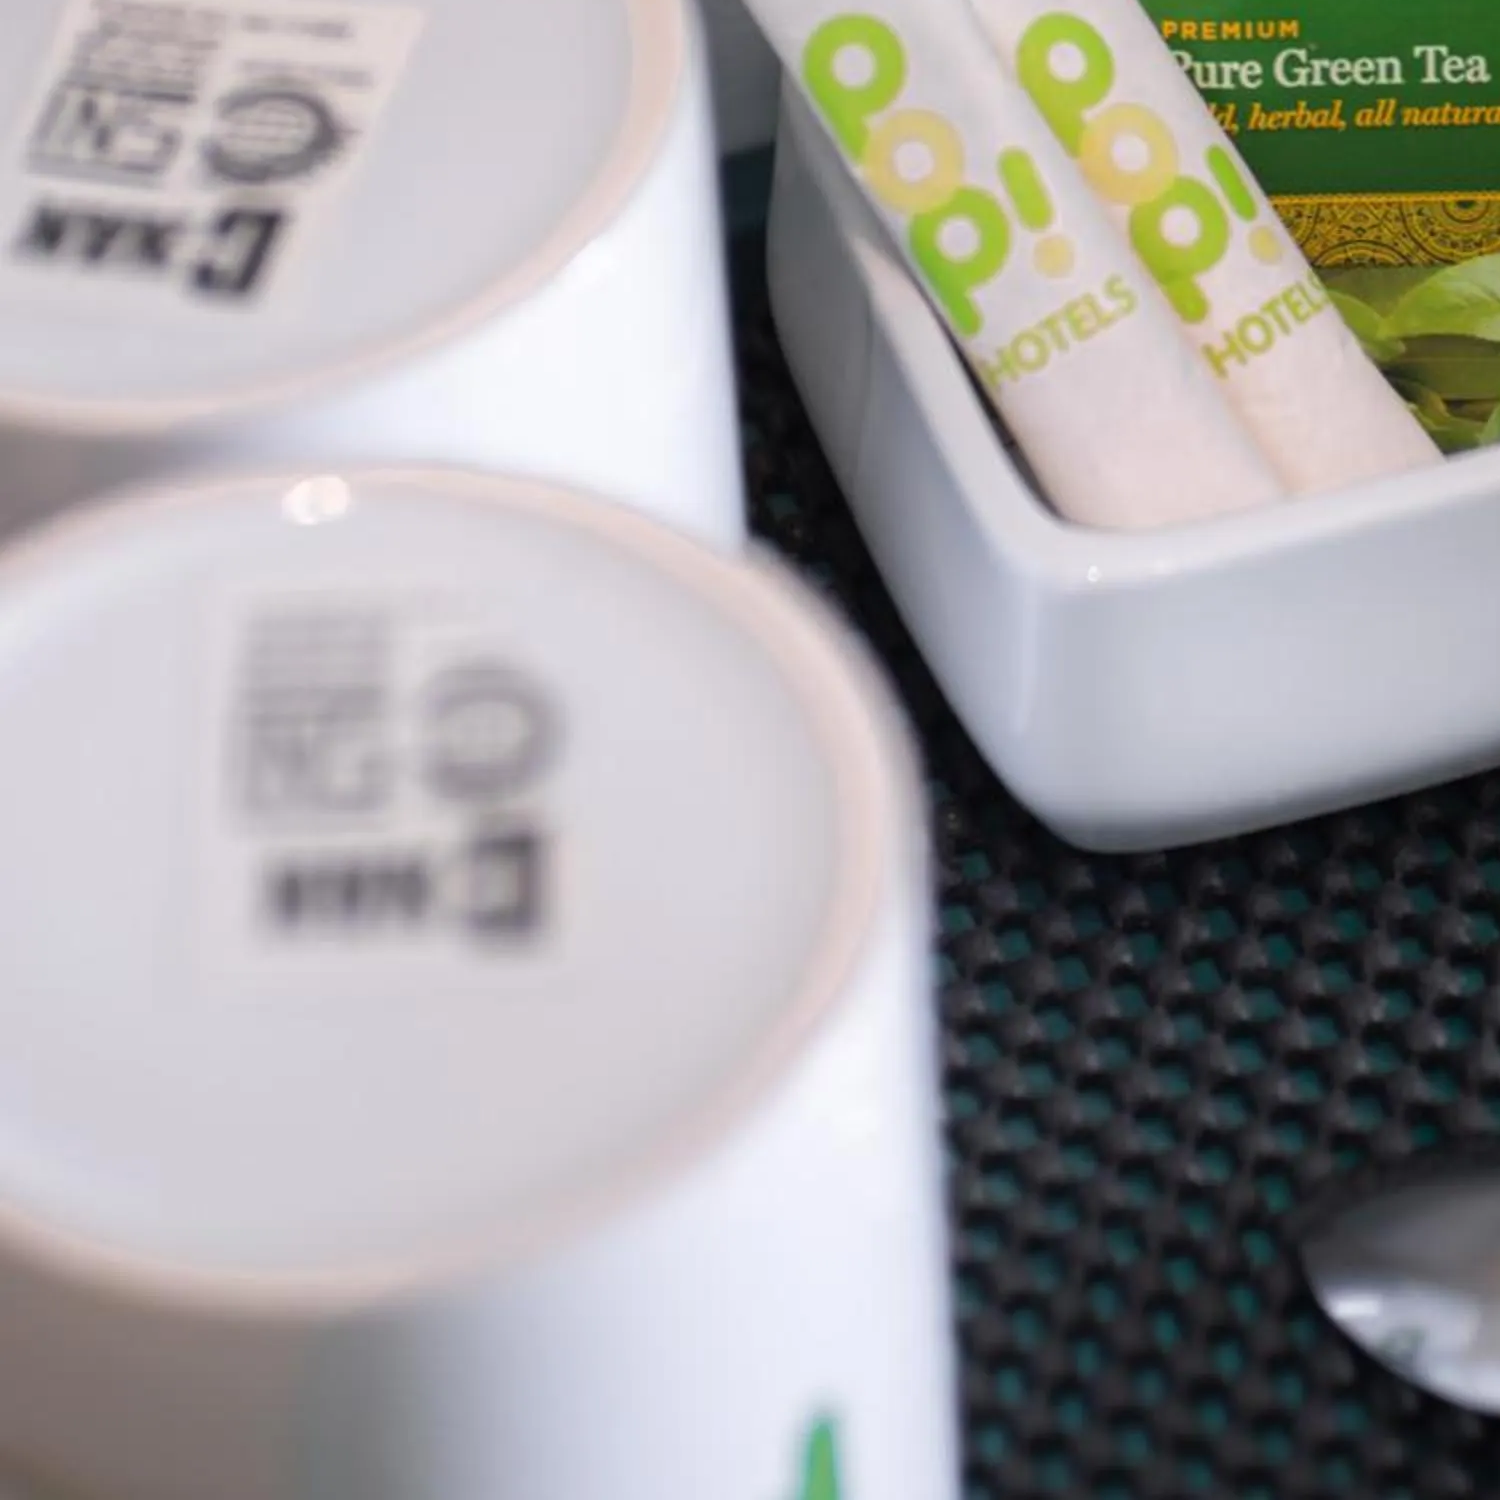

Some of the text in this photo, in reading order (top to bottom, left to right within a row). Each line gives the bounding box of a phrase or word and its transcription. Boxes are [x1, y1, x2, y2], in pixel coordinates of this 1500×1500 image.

[1162, 19, 1299, 40] PREMIUM
[1273, 48, 1405, 88] Green
[1413, 44, 1492, 84] Tea
[1248, 98, 1347, 132] herbal,
[1355, 97, 1398, 128] all
[975, 273, 1139, 387] HOTELS
